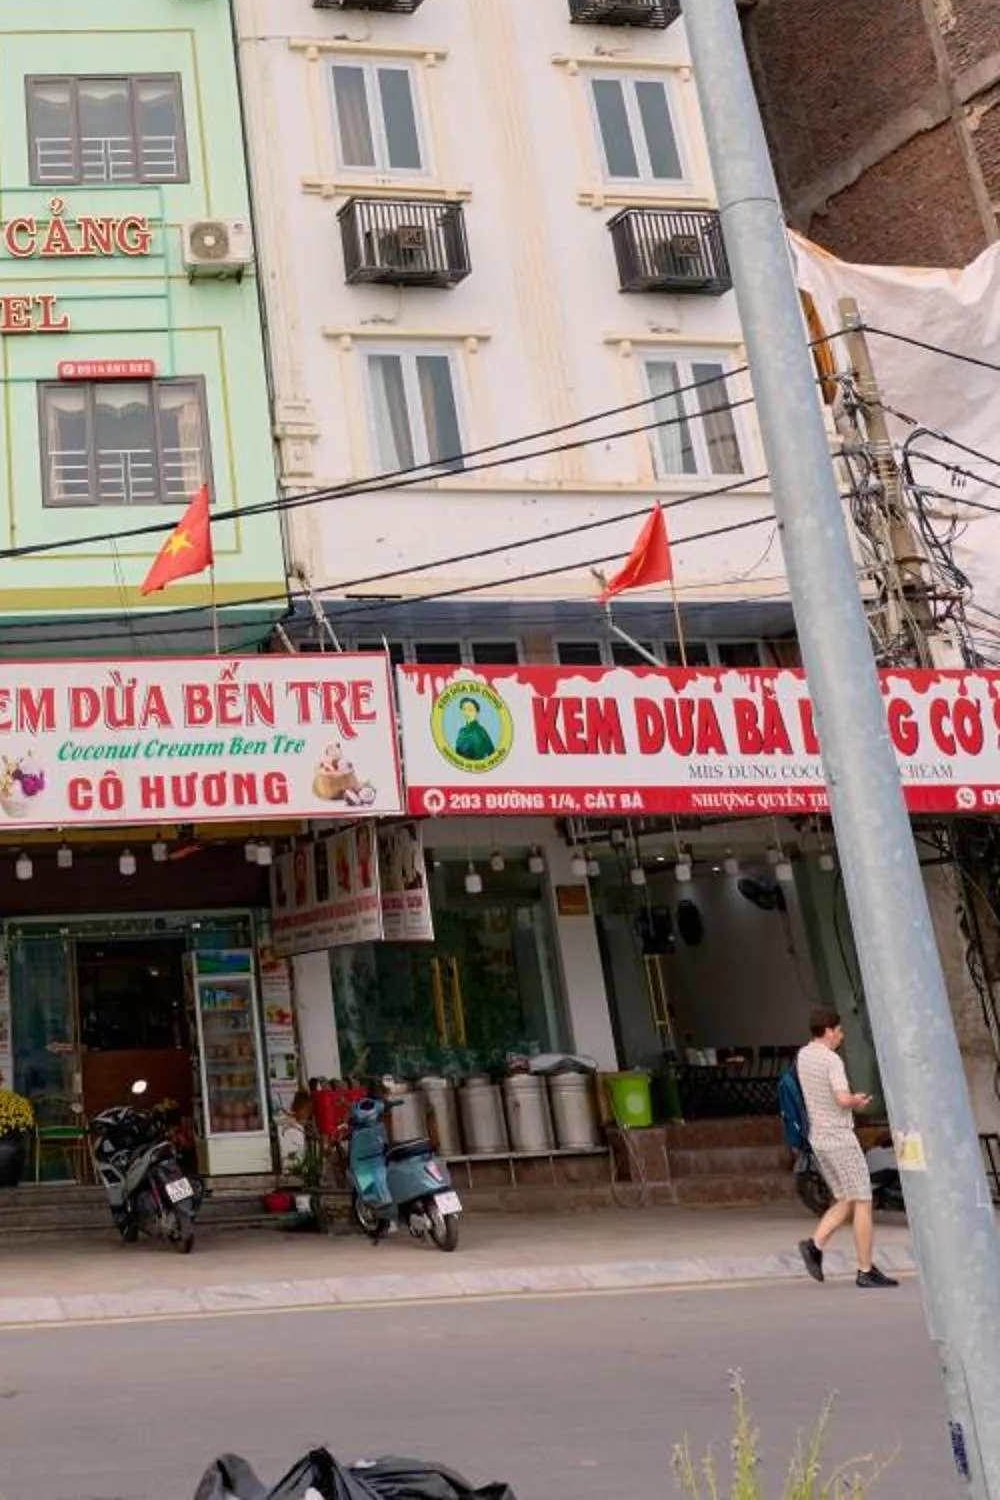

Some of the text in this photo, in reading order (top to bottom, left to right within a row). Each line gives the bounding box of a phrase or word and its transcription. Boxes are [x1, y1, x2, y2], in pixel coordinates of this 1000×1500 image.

[3, 197, 152, 257] CẢNG
[69, 671, 172, 735] DỪA
[183, 662, 276, 727] BẾN
[288, 680, 378, 738] TRE
[57, 740, 140, 761] Coconut
[229, 736, 266, 756] Ben
[272, 735, 305, 754] Tre
[531, 697, 627, 755] KEM
[930, 697, 983, 756] CƠ
[68, 770, 290, 811] CÔ HƯƠNG
[449, 794, 481, 809] 203
